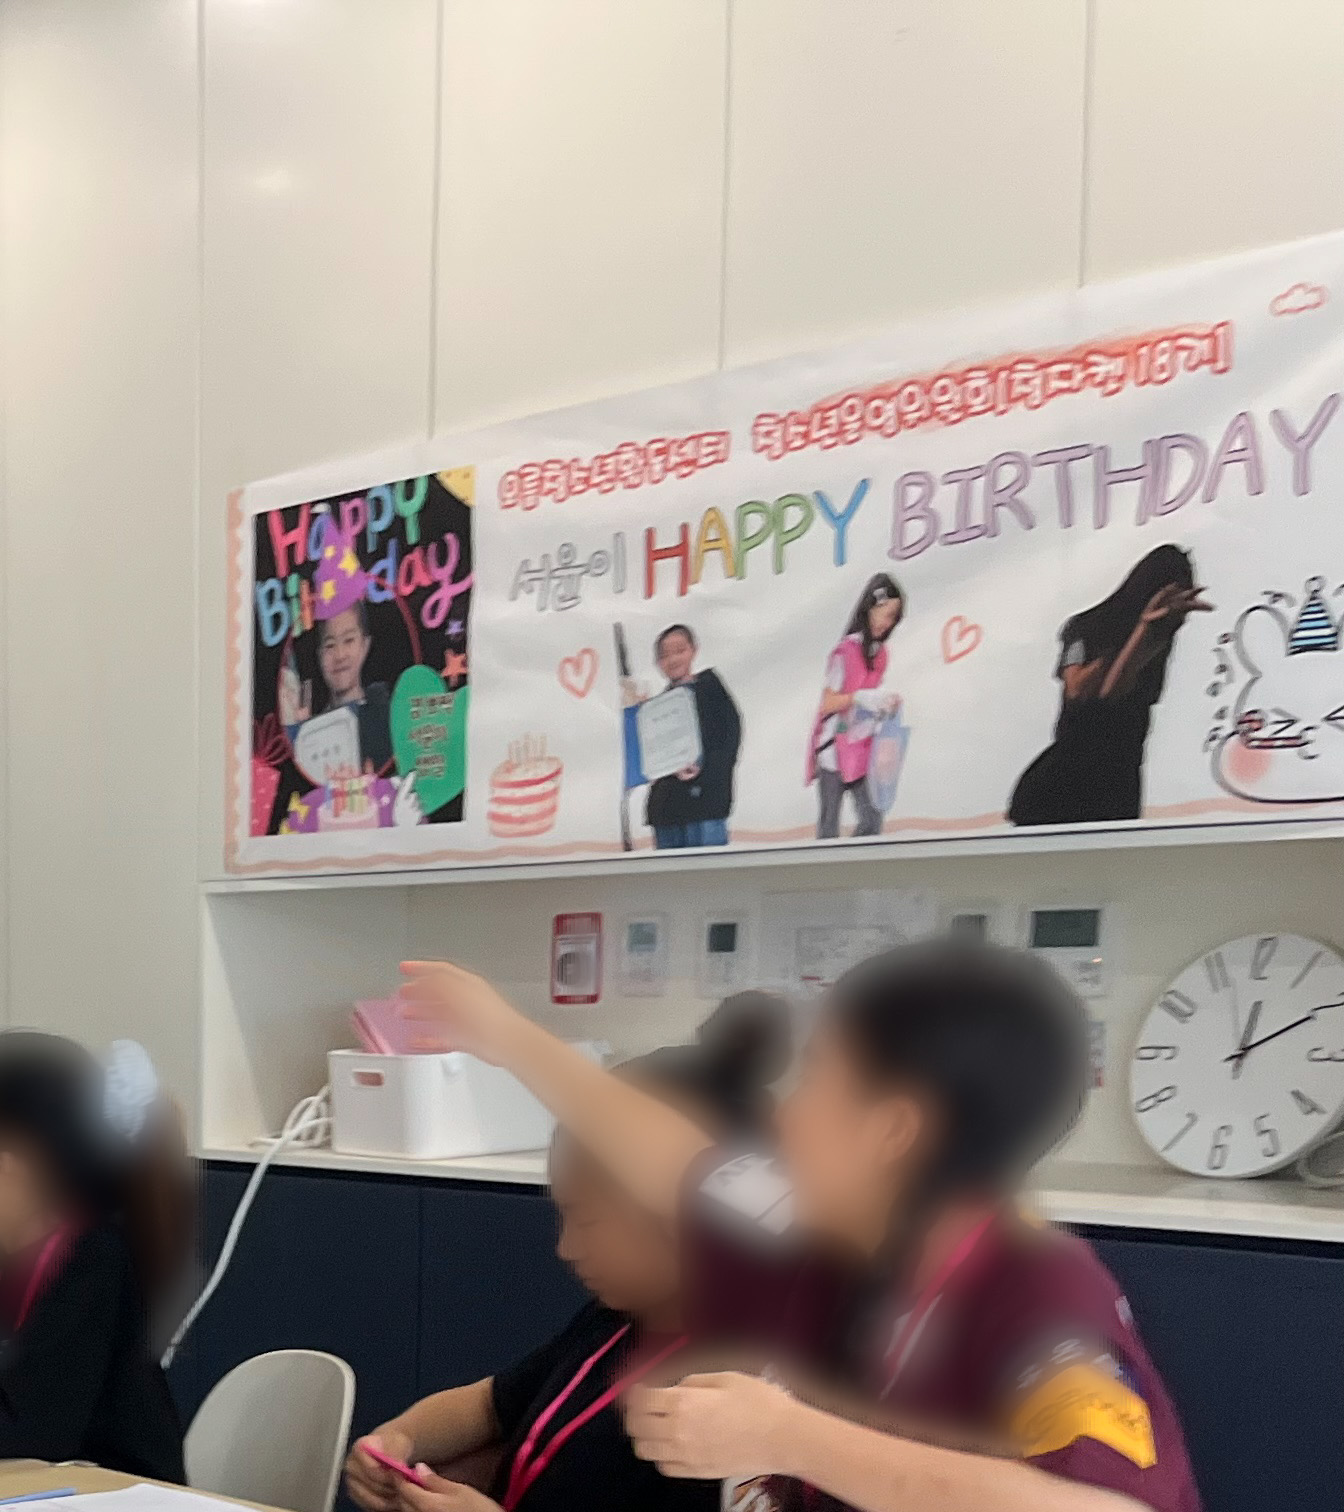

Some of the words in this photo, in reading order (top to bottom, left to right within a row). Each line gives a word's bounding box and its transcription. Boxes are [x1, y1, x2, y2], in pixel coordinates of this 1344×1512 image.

[508, 530, 628, 612] 서윤이
[643, 476, 869, 600] HAPPY
[887, 393, 1342, 562] BIRTHDAY
